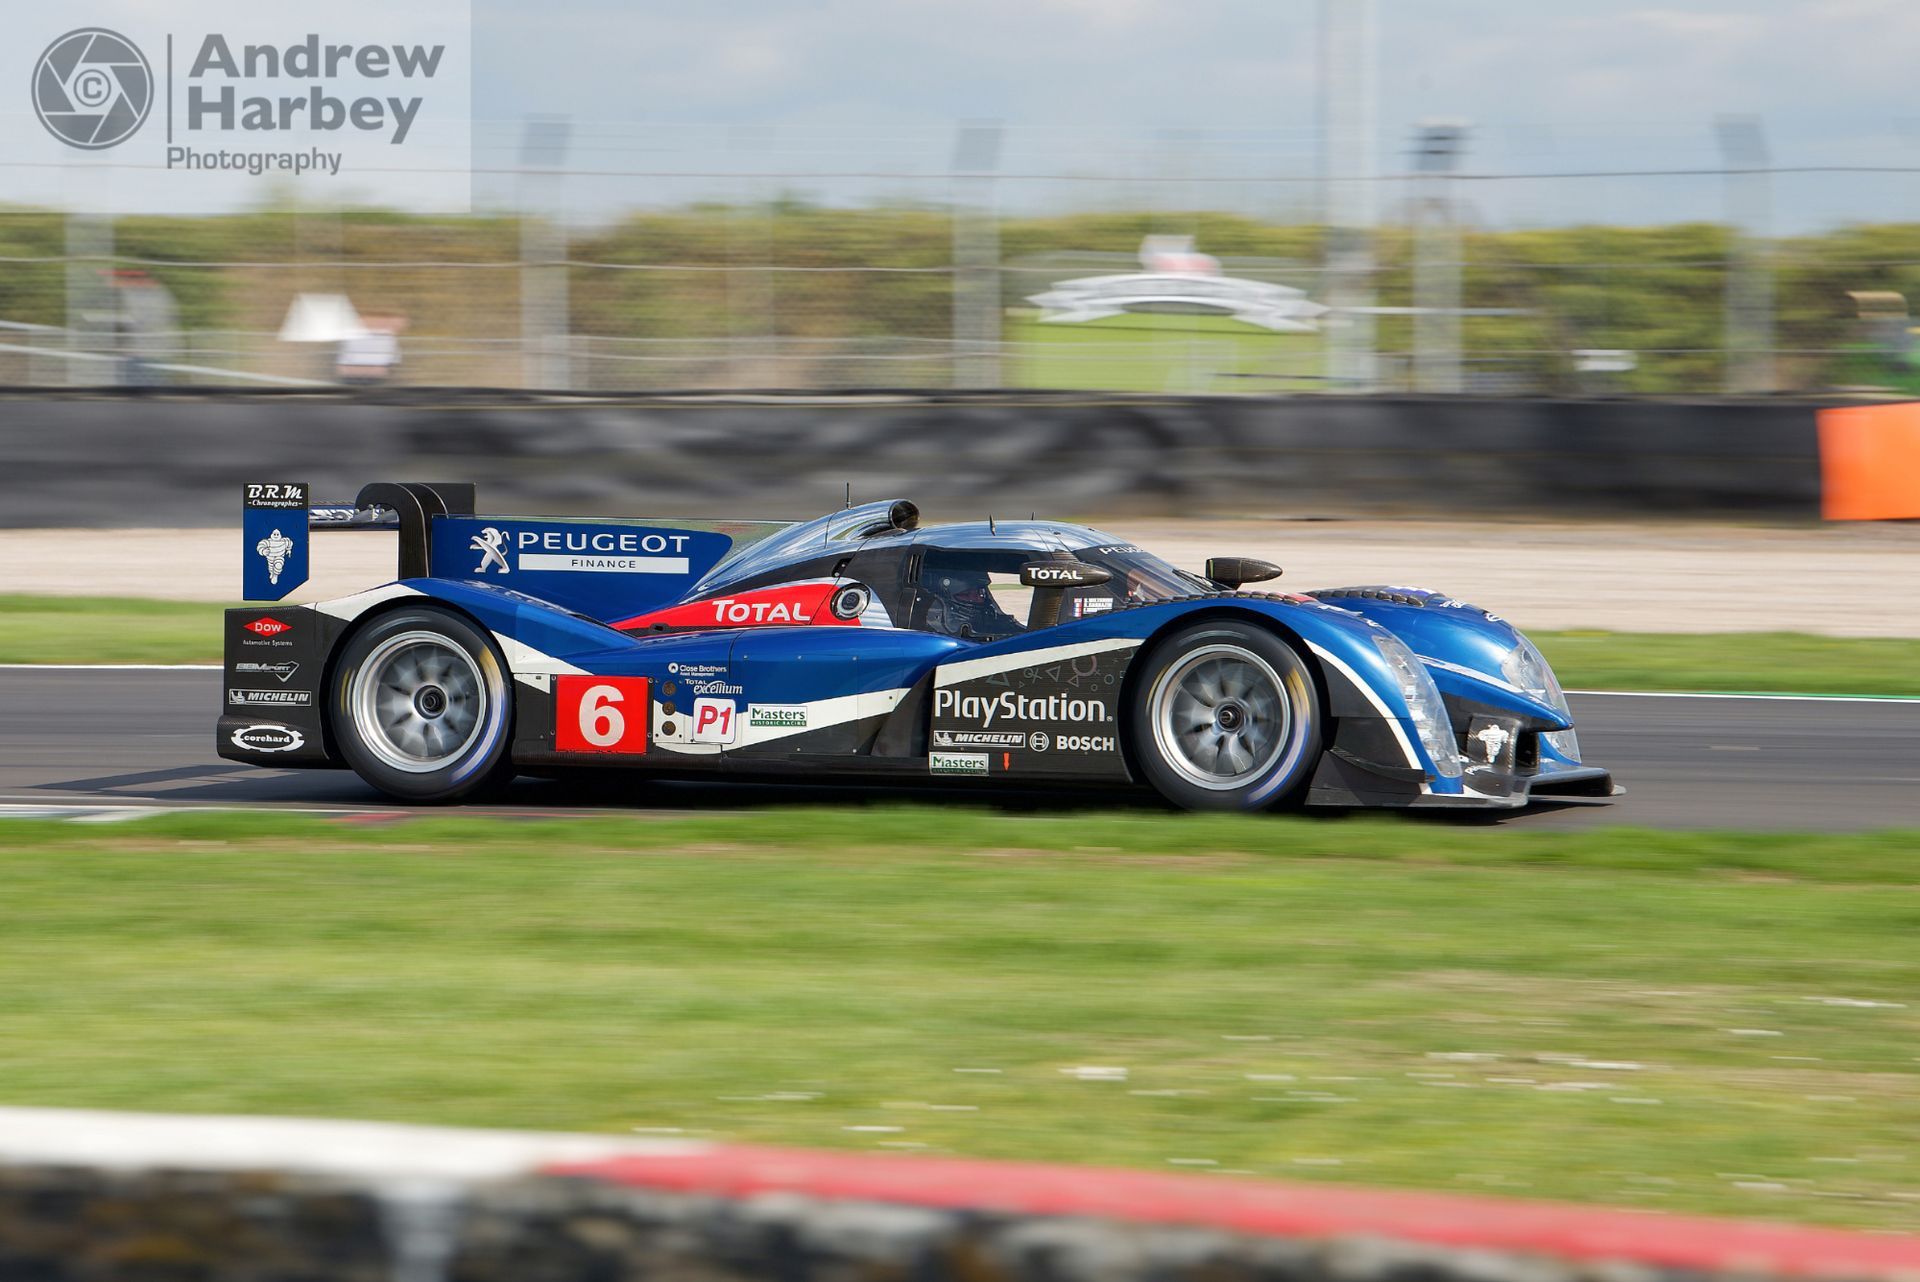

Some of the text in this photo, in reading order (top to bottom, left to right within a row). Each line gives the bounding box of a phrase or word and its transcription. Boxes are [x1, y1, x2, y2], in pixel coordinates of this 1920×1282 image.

[518, 532, 690, 553] PEUGEOT
[571, 559, 637, 568] FINANCE
[1027, 567, 1083, 580] TOTAL
[712, 600, 811, 623] TOTAL
[680, 664, 727, 673] Close Brothers
[693, 681, 743, 695] excellium
[248, 692, 309, 702] MICHELIN
[579, 685, 625, 747] 6
[697, 705, 732, 735] P1
[752, 707, 806, 720] Masters
[955, 733, 1023, 743] MICHELIN
[1056, 735, 1115, 751] BOSCH
[933, 756, 985, 769] Masters
